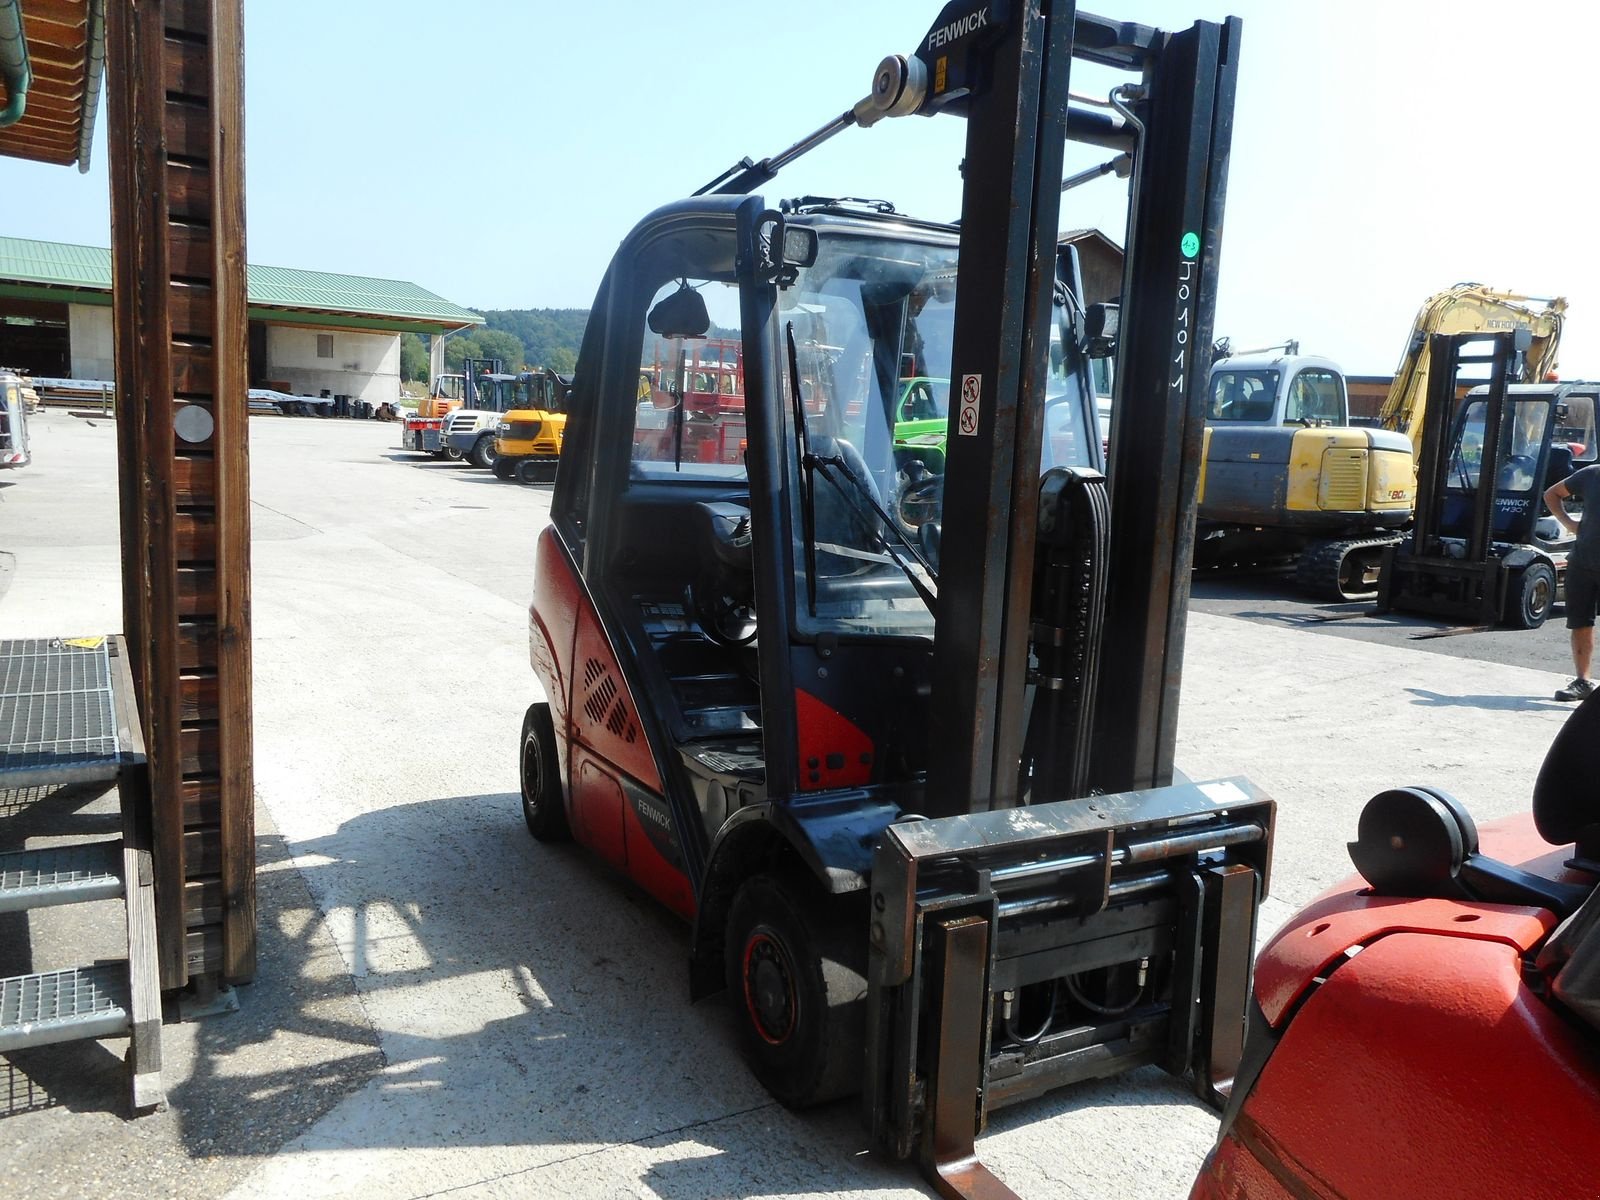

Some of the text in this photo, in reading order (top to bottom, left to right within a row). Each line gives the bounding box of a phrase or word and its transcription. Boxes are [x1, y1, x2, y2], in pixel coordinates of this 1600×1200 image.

[928, 7, 988, 51] FENWICK
[1487, 319, 1501, 329] NEW
[1496, 498, 1530, 507] ENWICK
[638, 799, 671, 831] FENWICK
